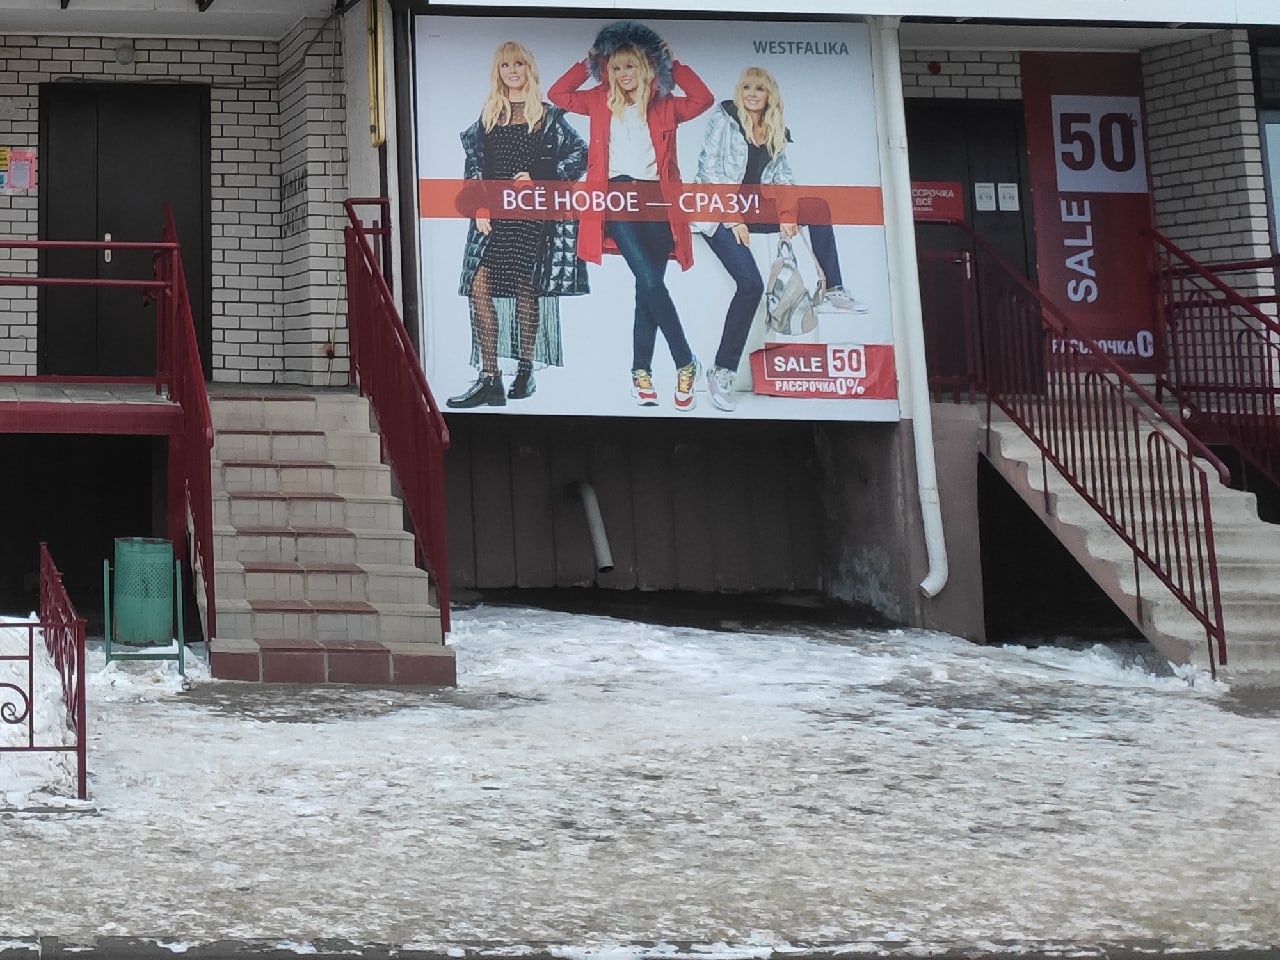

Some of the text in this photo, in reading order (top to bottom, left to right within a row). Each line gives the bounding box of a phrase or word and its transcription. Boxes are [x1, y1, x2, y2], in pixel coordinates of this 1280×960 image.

[752, 40, 850, 57] WESTFALIKA
[502, 186, 547, 211] ВСЁ
[554, 190, 640, 213] НОВОЕ
[678, 191, 762, 214] СРАЗУ!
[1060, 198, 1099, 304] SALE
[773, 348, 862, 373] SALE 50
